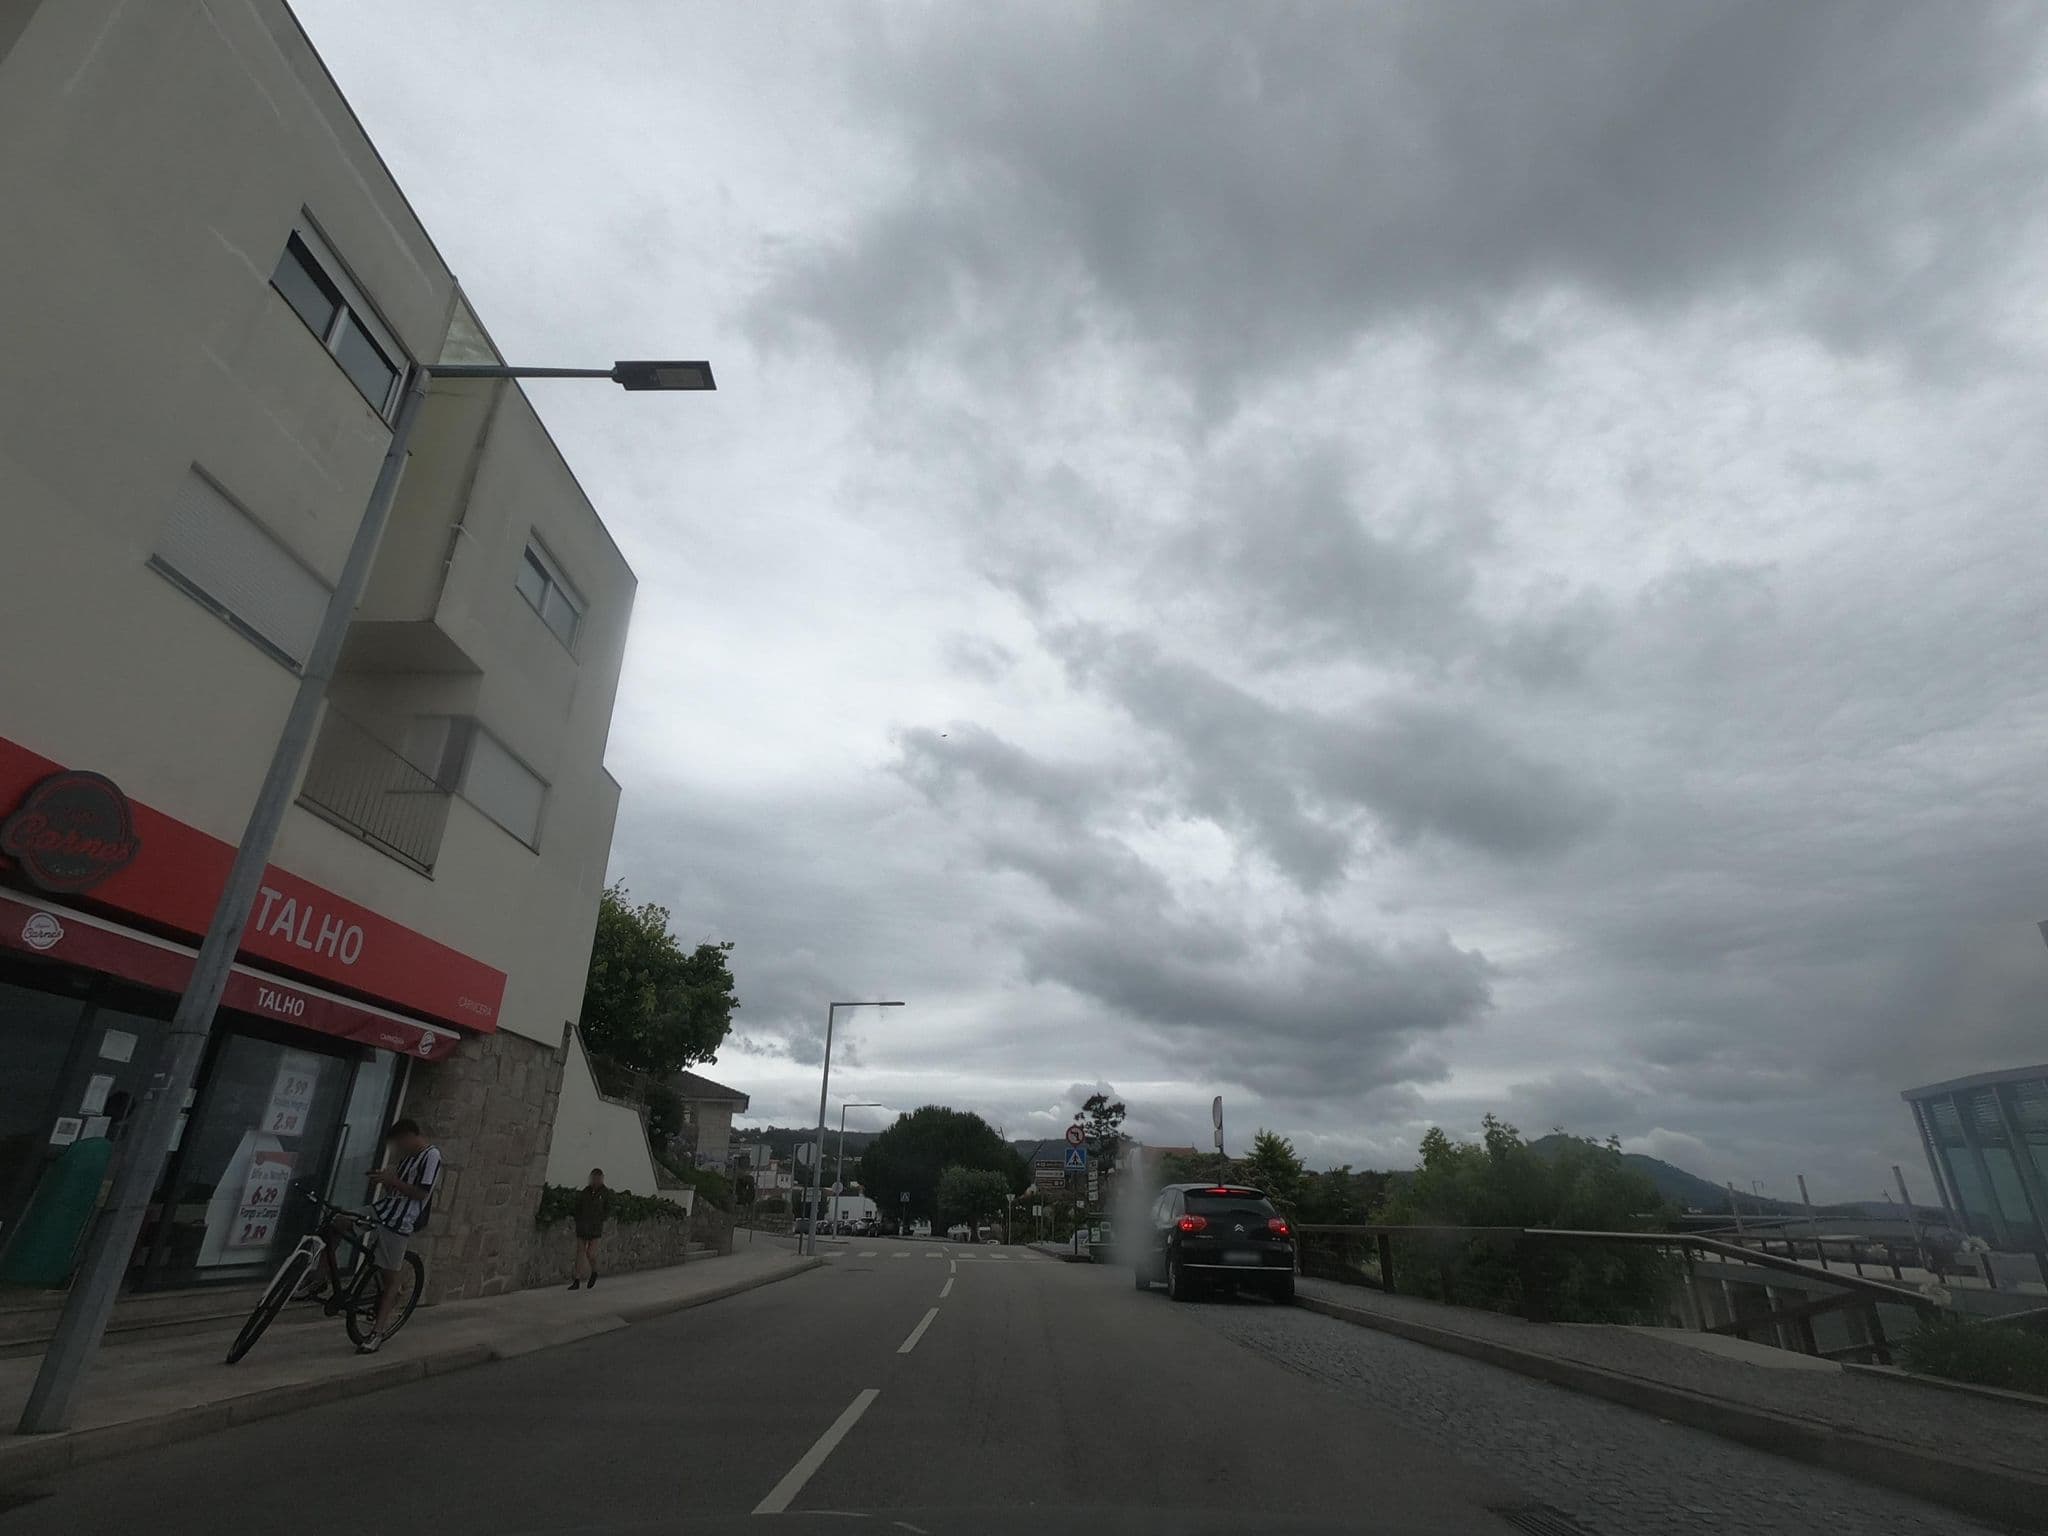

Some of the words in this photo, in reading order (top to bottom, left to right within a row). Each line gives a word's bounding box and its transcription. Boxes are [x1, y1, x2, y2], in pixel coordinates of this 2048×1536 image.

[256, 886, 364, 965] TALHO
[257, 987, 305, 1017] TALHO
[251, 1186, 278, 1205] 6.29
